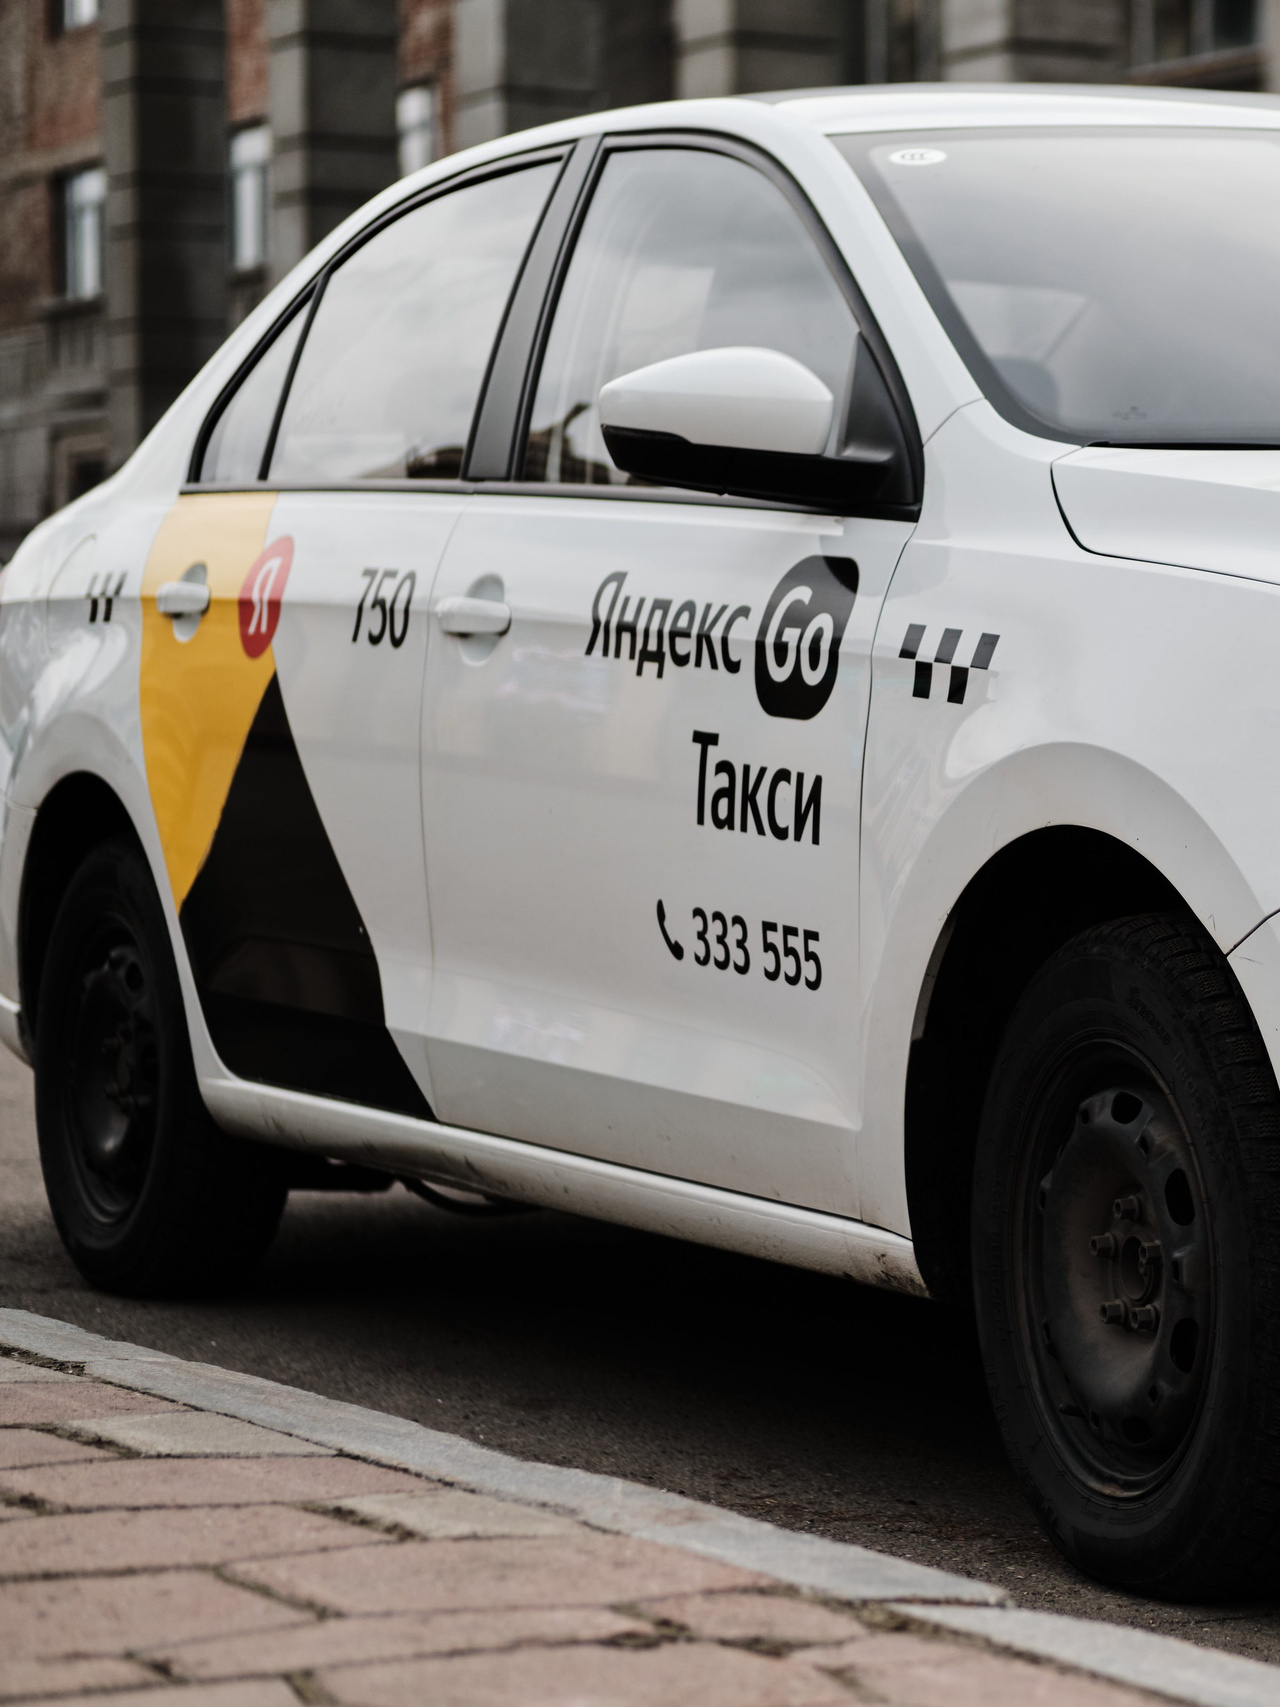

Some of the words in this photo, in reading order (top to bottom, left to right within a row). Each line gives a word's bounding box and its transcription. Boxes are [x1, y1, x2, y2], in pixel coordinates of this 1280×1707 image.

[247, 556, 284, 636] Я
[351, 567, 417, 650] 750
[585, 570, 752, 680] Яндекс
[764, 584, 835, 687] Go
[691, 729, 823, 846] Такси
[691, 906, 751, 976] 333
[761, 920, 823, 992] 555
